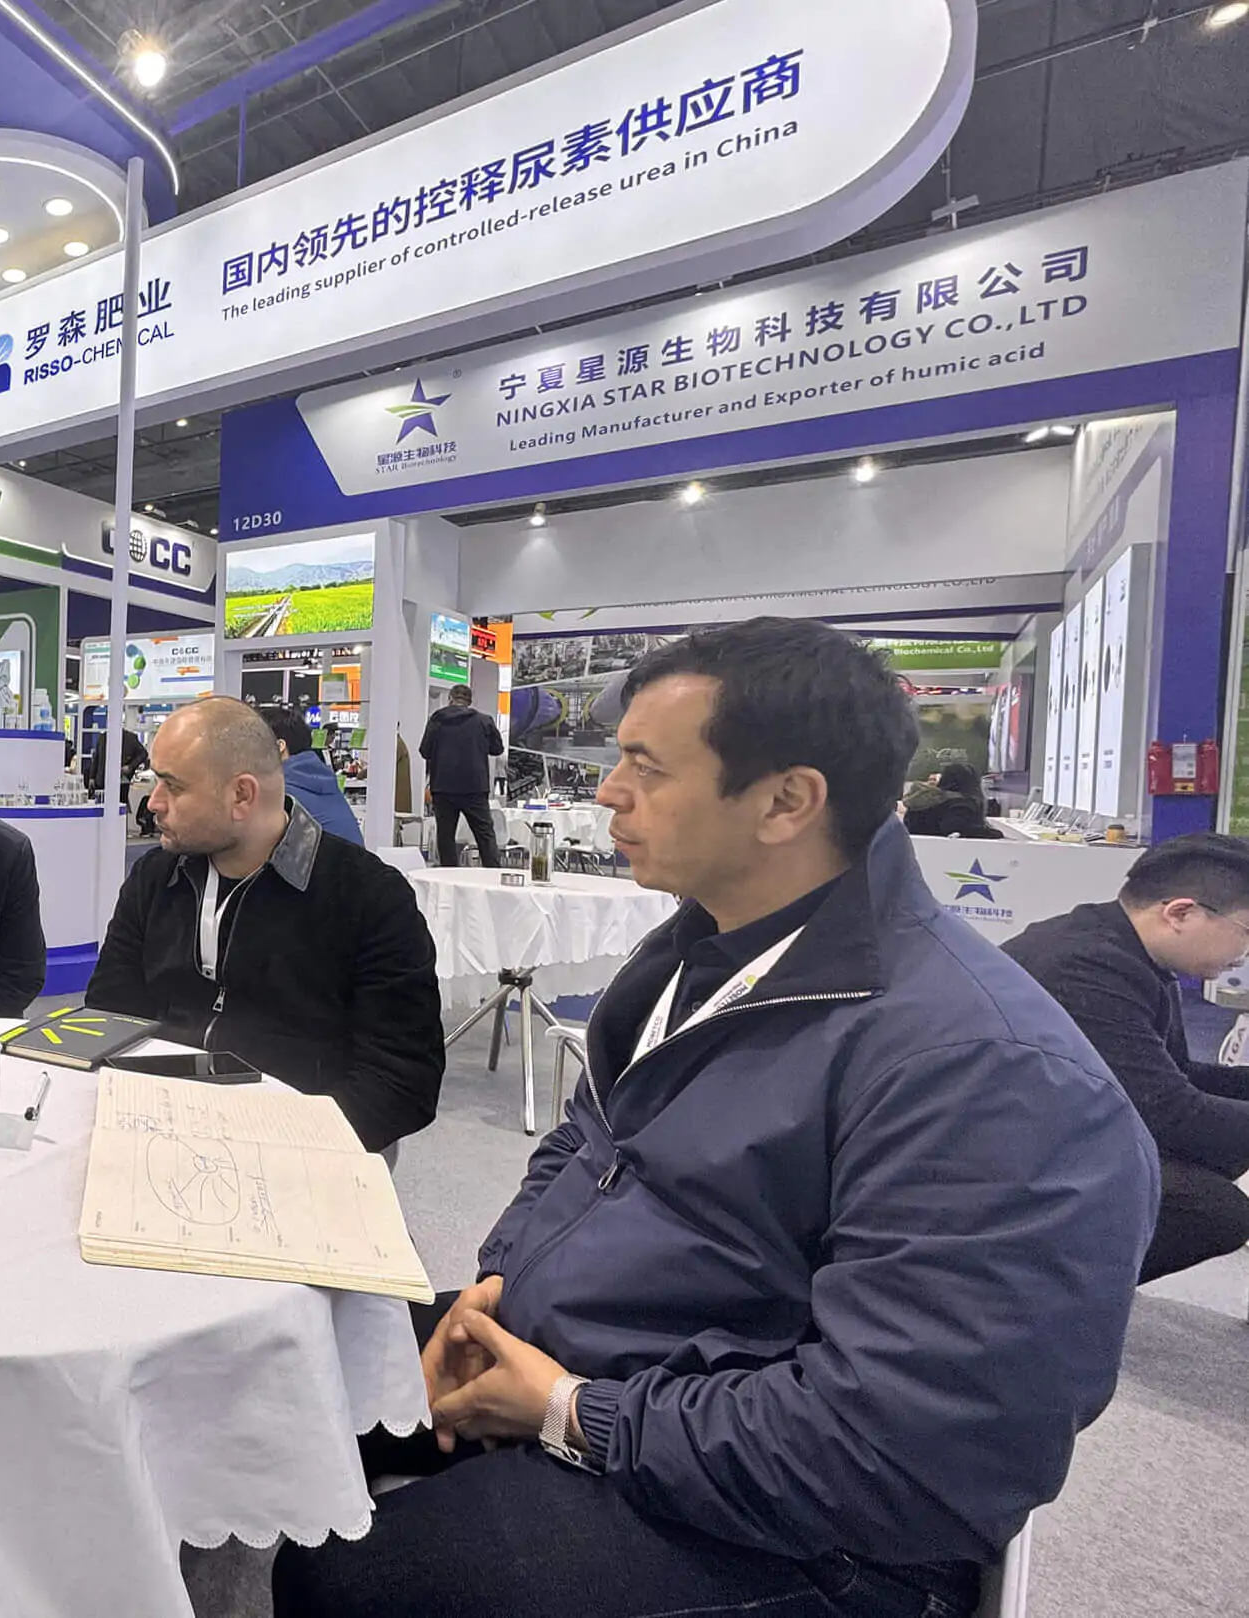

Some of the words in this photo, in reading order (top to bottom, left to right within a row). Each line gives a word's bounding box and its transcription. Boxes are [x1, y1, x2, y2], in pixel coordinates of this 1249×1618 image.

[221, 303, 249, 321] The
[253, 283, 312, 311] leading
[314, 258, 386, 293] supplier
[391, 247, 411, 266] of
[414, 181, 613, 258] controlled-release
[620, 161, 676, 190] urea
[684, 149, 708, 170] in
[717, 120, 798, 157] China
[222, 49, 803, 295] 国内领先的控释尿素供应商
[24, 321, 175, 385] RISSO-CHECAL
[25, 277, 172, 360] 罗森肥业
[496, 395, 596, 427] NINGXIA
[603, 379, 667, 406] STAR
[674, 324, 936, 392] BIOTECHNOLOGY
[945, 295, 1088, 338] CO.,LTD
[498, 246, 1089, 400] 宁夏星源生物科技有限公司
[509, 430, 576, 451] Leading
[582, 405, 714, 439] Manufacturer
[718, 395, 756, 414] and
[764, 377, 864, 406] Exporter
[870, 369, 895, 387] of
[902, 356, 980, 382] humic
[988, 342, 1045, 367] acid
[233, 511, 282, 532] 12D30
[894, 645, 954, 656] Biochemical
